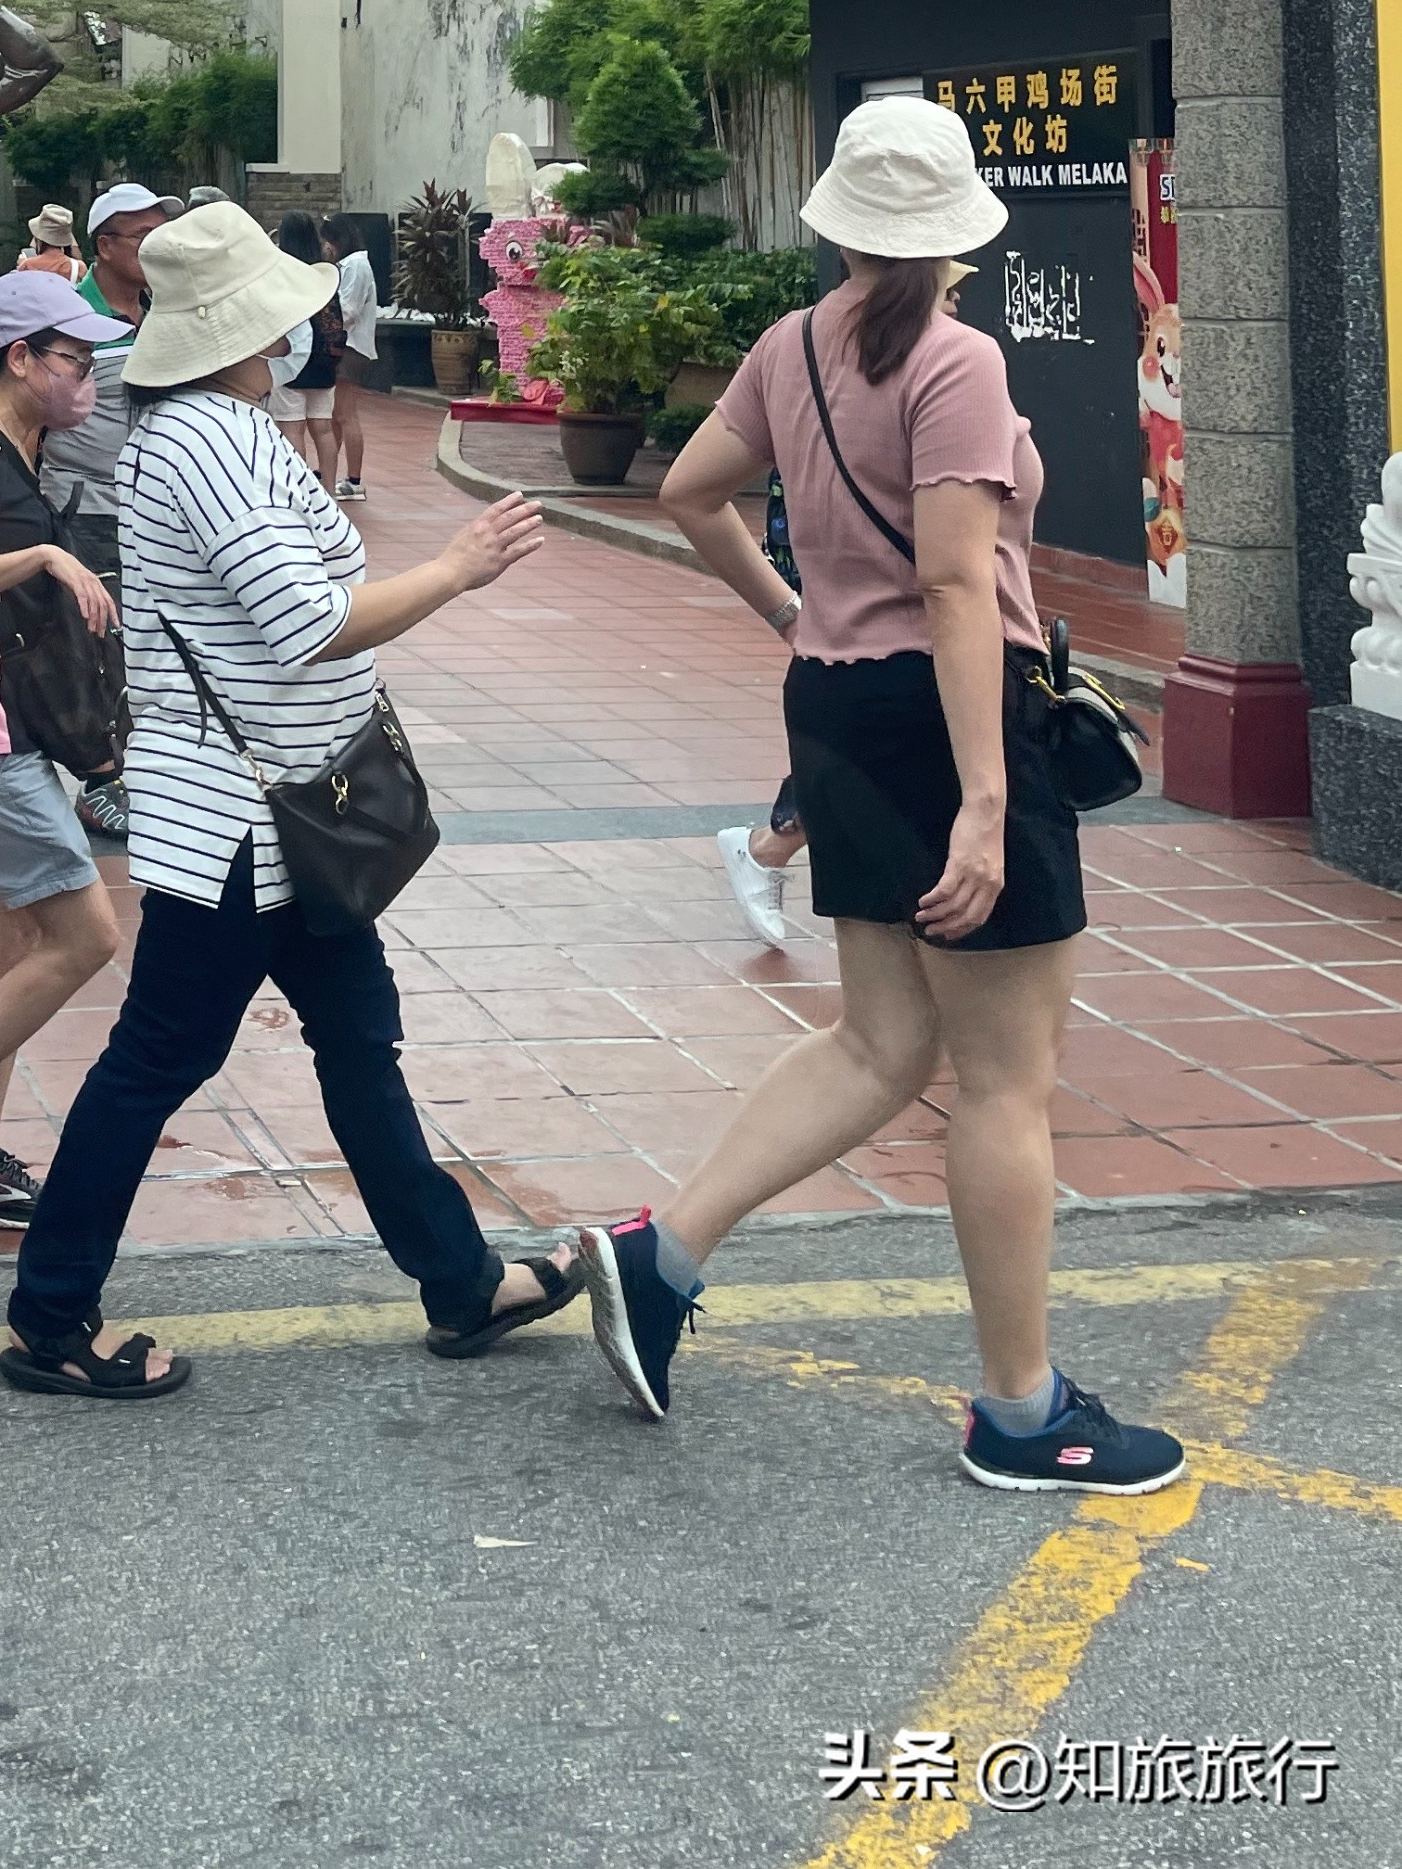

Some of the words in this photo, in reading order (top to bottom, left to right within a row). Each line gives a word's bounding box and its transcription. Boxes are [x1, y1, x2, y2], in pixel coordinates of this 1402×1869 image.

[936, 64, 1118, 115] 马六甲鸡场街
[982, 113, 1068, 157] 文化坊
[1007, 164, 1054, 187] WALK
[1058, 161, 1128, 186] MELAKA
